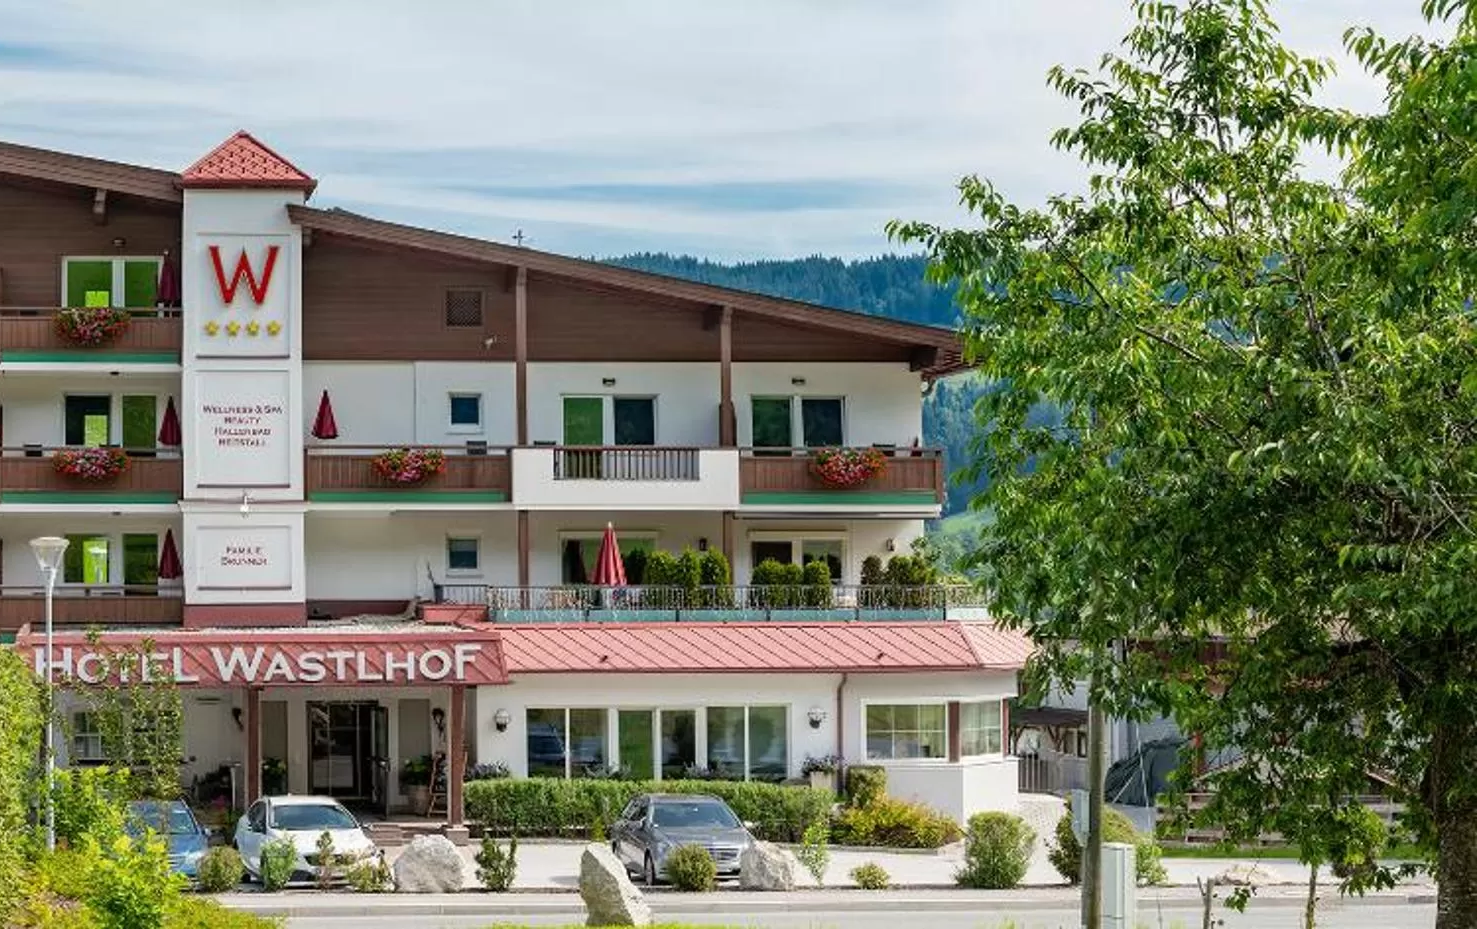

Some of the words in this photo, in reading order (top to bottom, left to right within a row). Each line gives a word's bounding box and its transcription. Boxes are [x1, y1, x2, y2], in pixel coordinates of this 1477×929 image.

[209, 245, 279, 305] W
[264, 404, 283, 414] SPA
[35, 646, 200, 685] HOTEL
[211, 643, 482, 683] WASTLHOF
